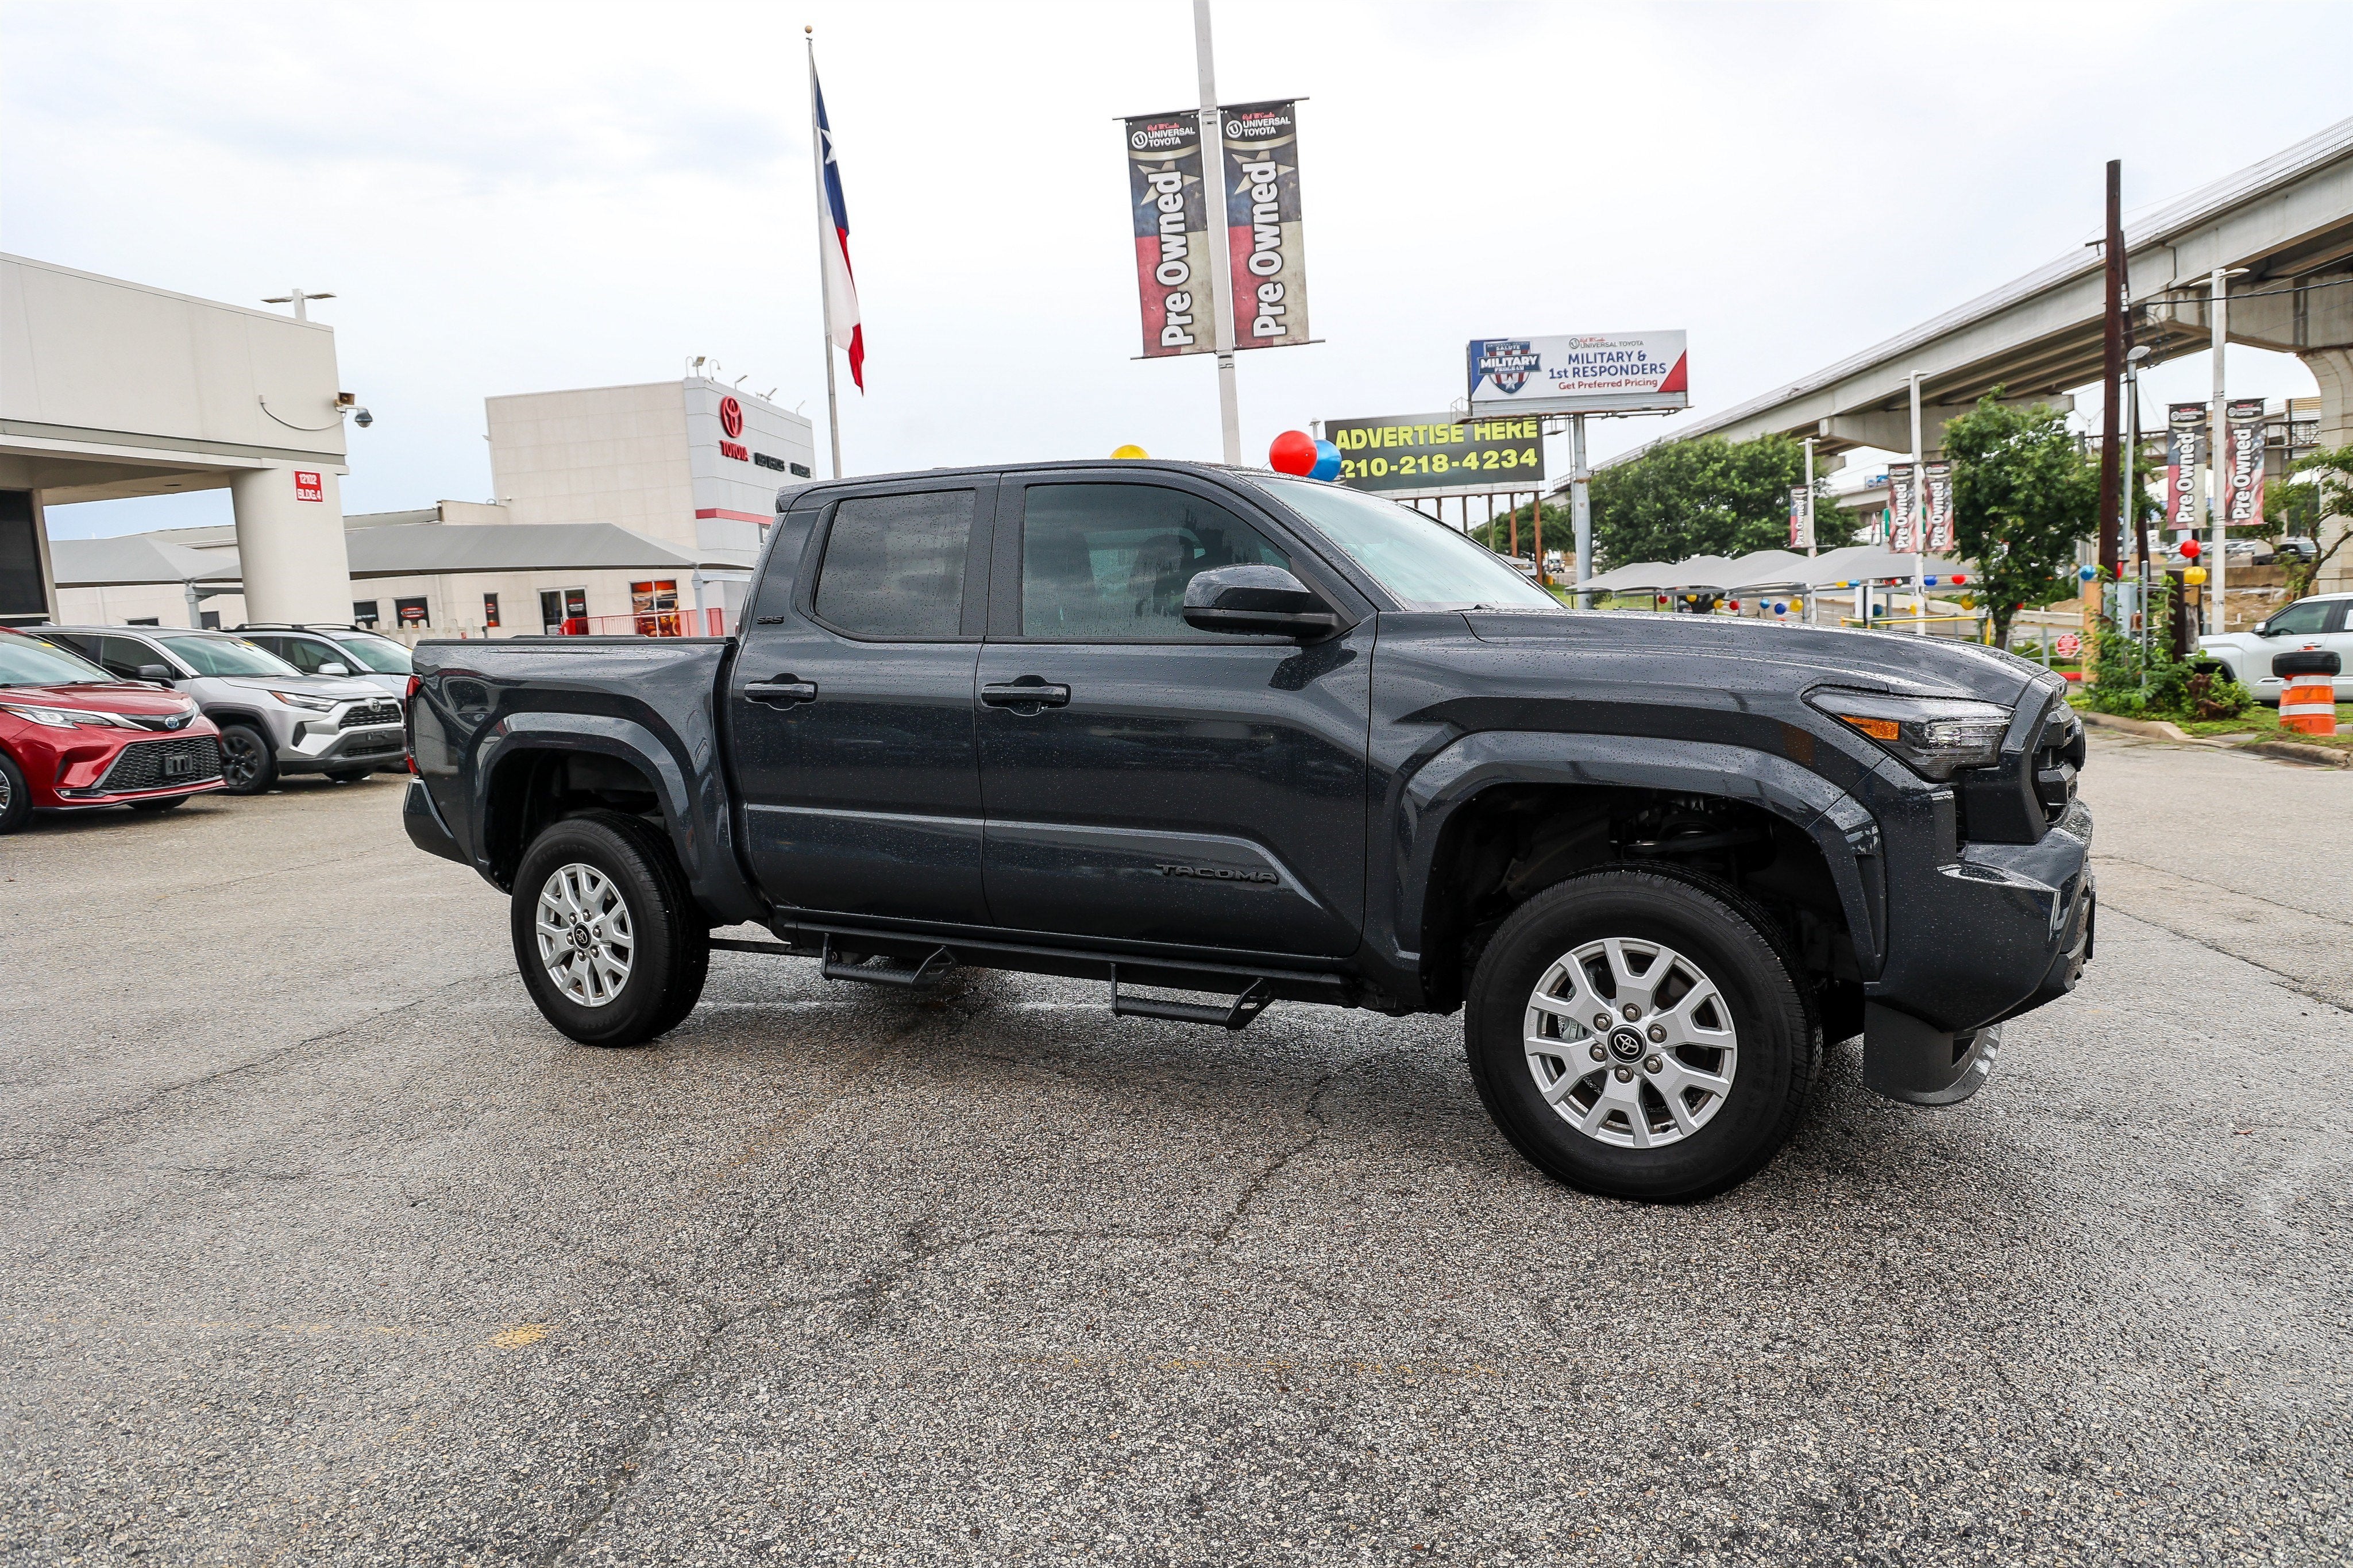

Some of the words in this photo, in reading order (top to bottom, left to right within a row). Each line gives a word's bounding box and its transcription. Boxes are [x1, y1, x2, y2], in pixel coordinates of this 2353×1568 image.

[1148, 127, 1195, 138] UNIVERSAL
[1243, 116, 1291, 128] UNIVERSAL
[1244, 126, 1276, 137] TOYOTA
[1149, 137, 1181, 148] TOYOTA
[1148, 171, 1190, 286] Owned
[1242, 161, 1283, 276] Owned
[1162, 292, 1194, 347] Pre
[1253, 282, 1287, 337] Pre
[1480, 356, 1538, 369] MILITARY
[1568, 350, 1634, 365] MILITARY
[1638, 350, 1647, 361] &
[1549, 368, 1569, 379] 1st
[1573, 362, 1667, 378] RESPONDERS
[1559, 381, 1575, 390] Get
[1578, 379, 1622, 389] Preferred
[1625, 378, 1658, 388] Pricing
[1336, 423, 1464, 450] ADVERTISE
[1474, 418, 1537, 442] HERE
[720, 440, 749, 461] TOYOTA
[2232, 428, 2251, 488] Owned
[1341, 448, 1537, 478] 210-218-4234
[2175, 432, 2195, 492] Owned
[1893, 484, 1908, 526] Owned
[1930, 482, 1944, 524] Owned
[2175, 494, 2194, 523] Pre
[2232, 490, 2251, 519] Pre
[1795, 500, 1804, 529] Owned
[1794, 531, 1804, 545] Pre
[1895, 528, 1909, 549] Pre
[1931, 526, 1945, 546] Pre
[757, 616, 785, 624] SR5
[1156, 864, 1279, 885] TACOMA
